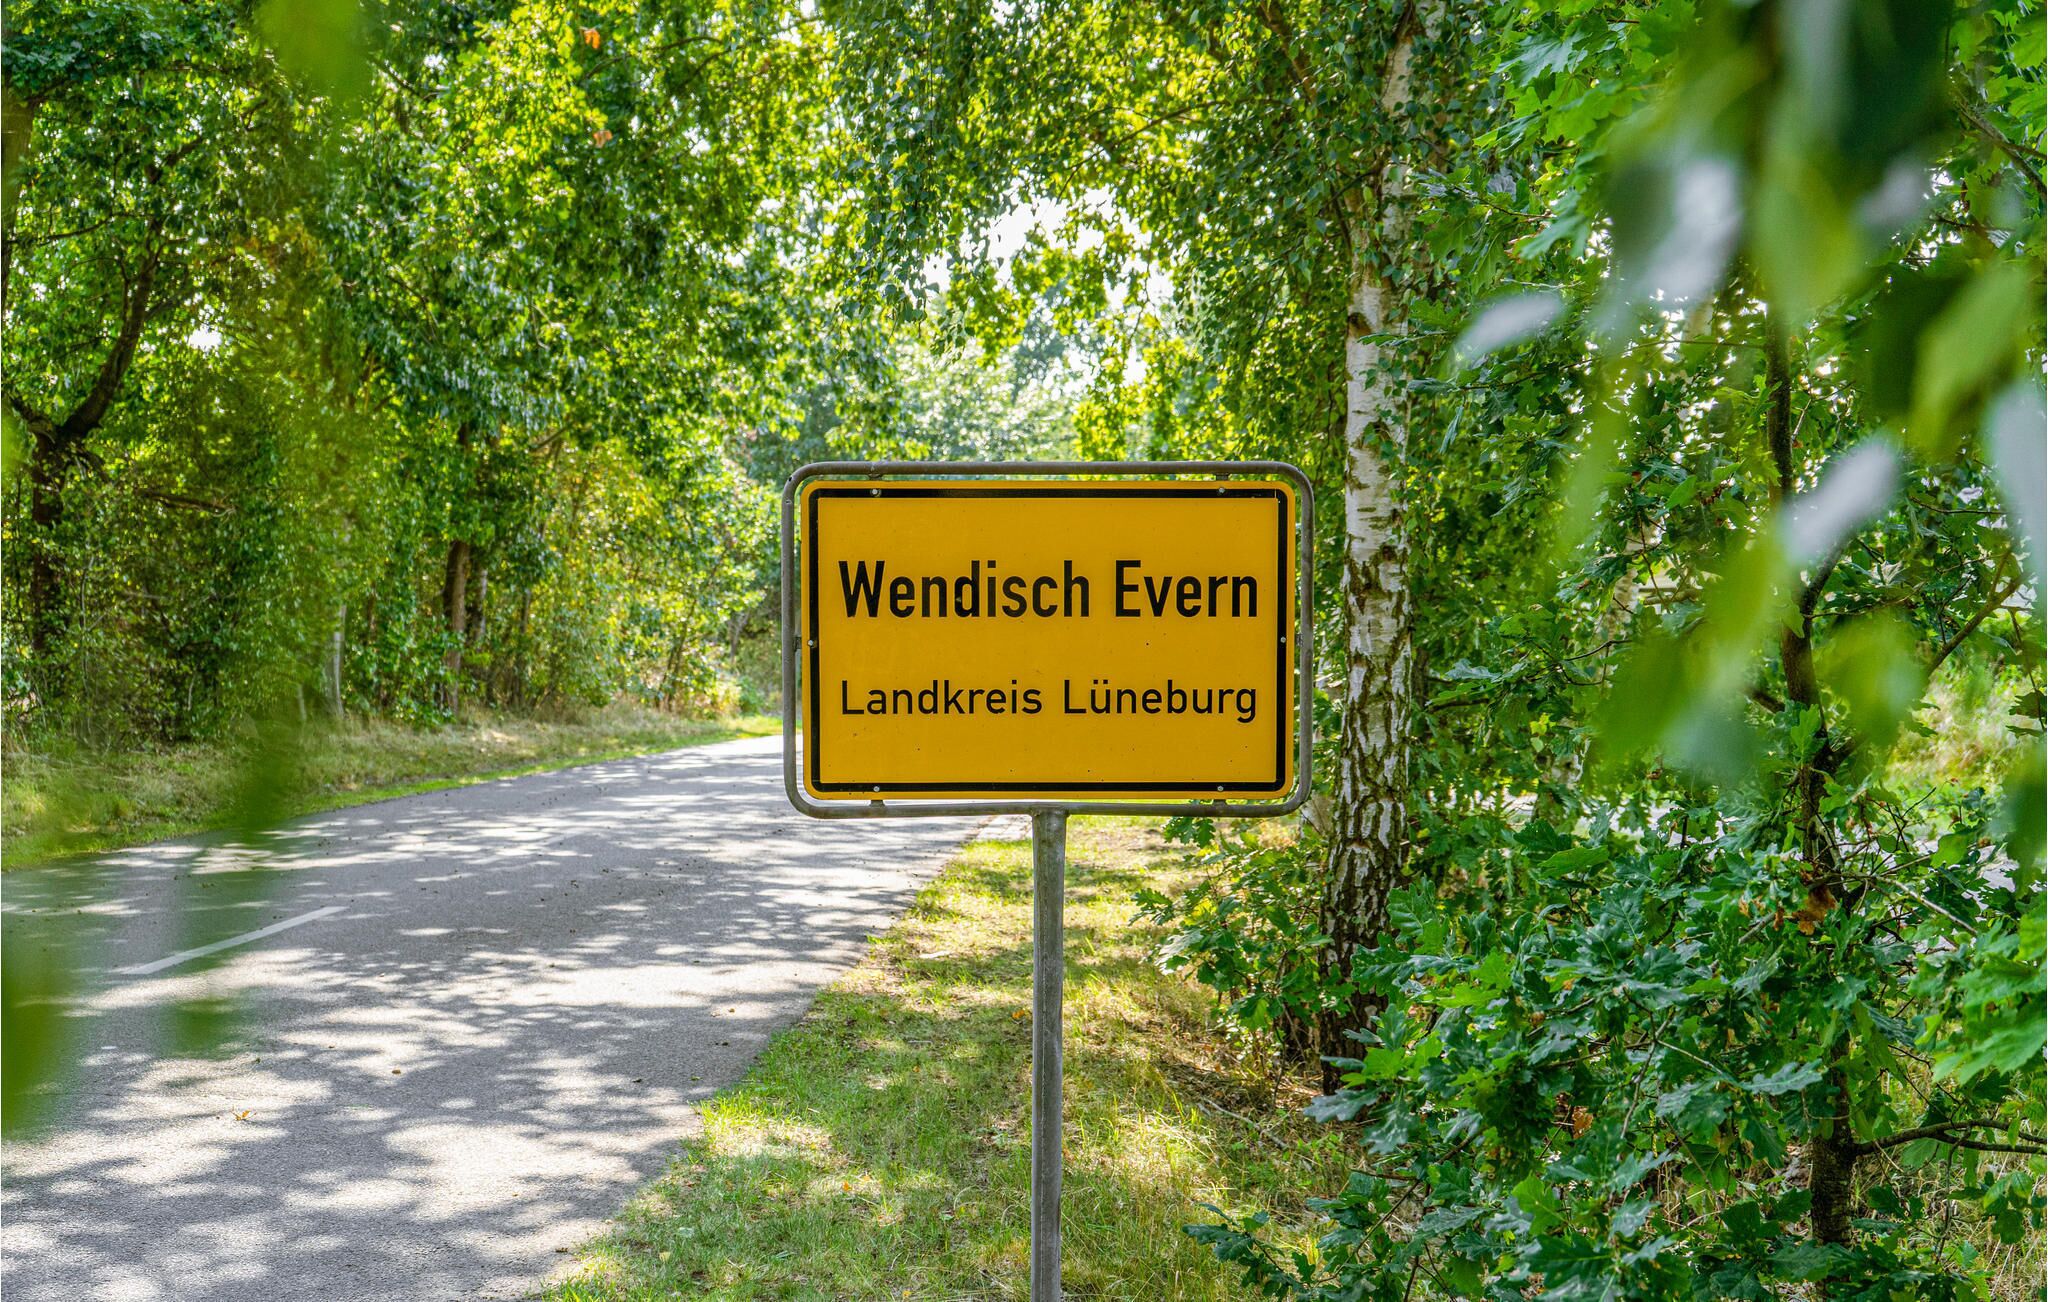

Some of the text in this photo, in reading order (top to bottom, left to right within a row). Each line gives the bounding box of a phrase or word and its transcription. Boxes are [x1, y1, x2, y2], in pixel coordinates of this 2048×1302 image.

[838, 559, 1258, 618] Wendisch Evern
[841, 679, 1256, 724] Landkreis Lüneburg
